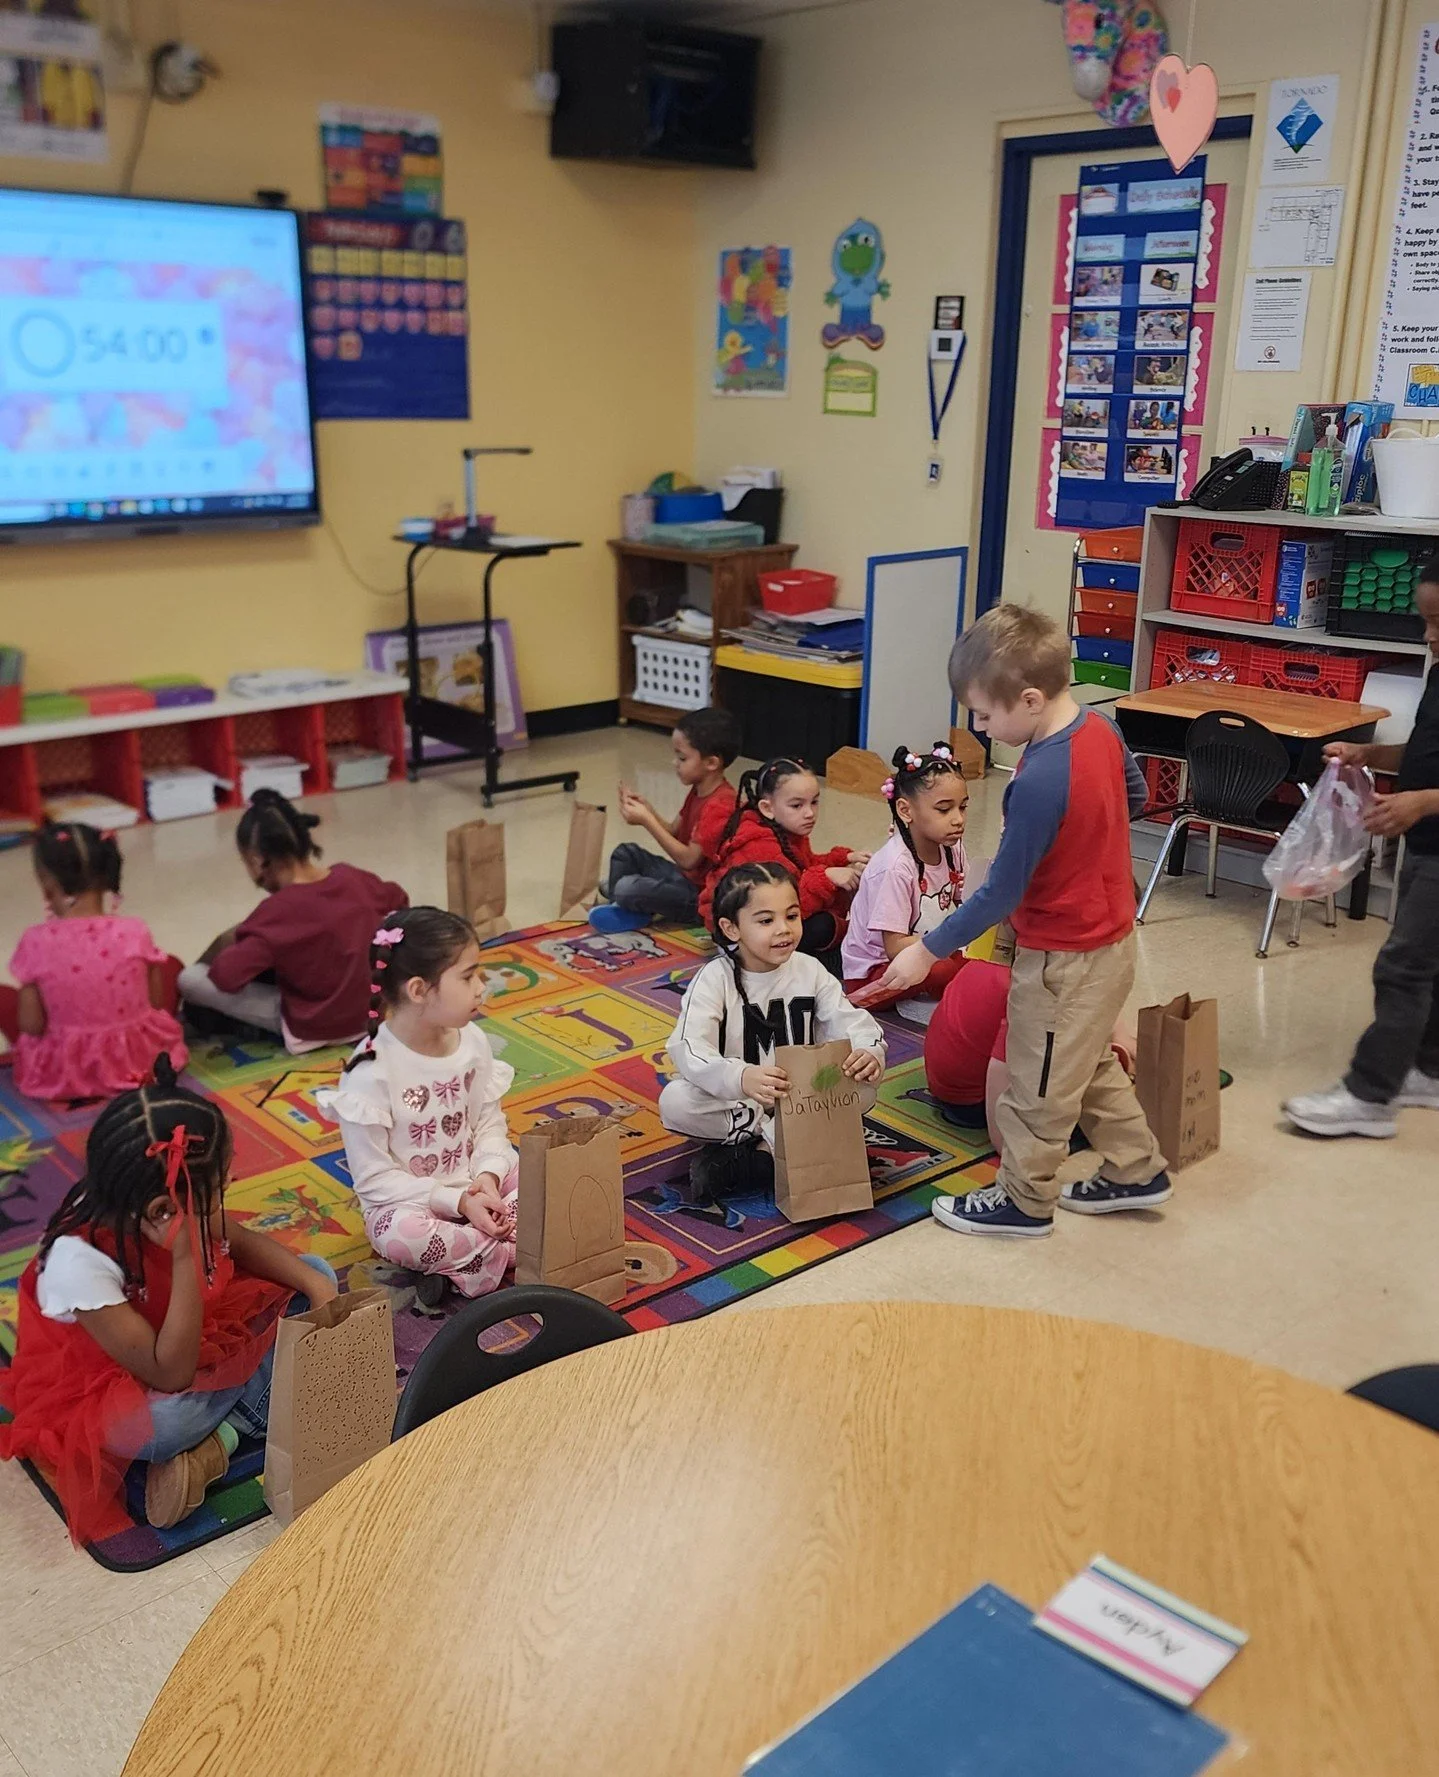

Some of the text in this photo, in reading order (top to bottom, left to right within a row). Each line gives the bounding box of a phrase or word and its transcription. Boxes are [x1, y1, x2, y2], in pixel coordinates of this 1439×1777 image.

[1416, 156, 1433, 164] your
[1422, 179, 1439, 187] Stay
[1404, 239, 1426, 247] happy
[1401, 325, 1420, 333] Keep
[1421, 325, 1438, 333] your
